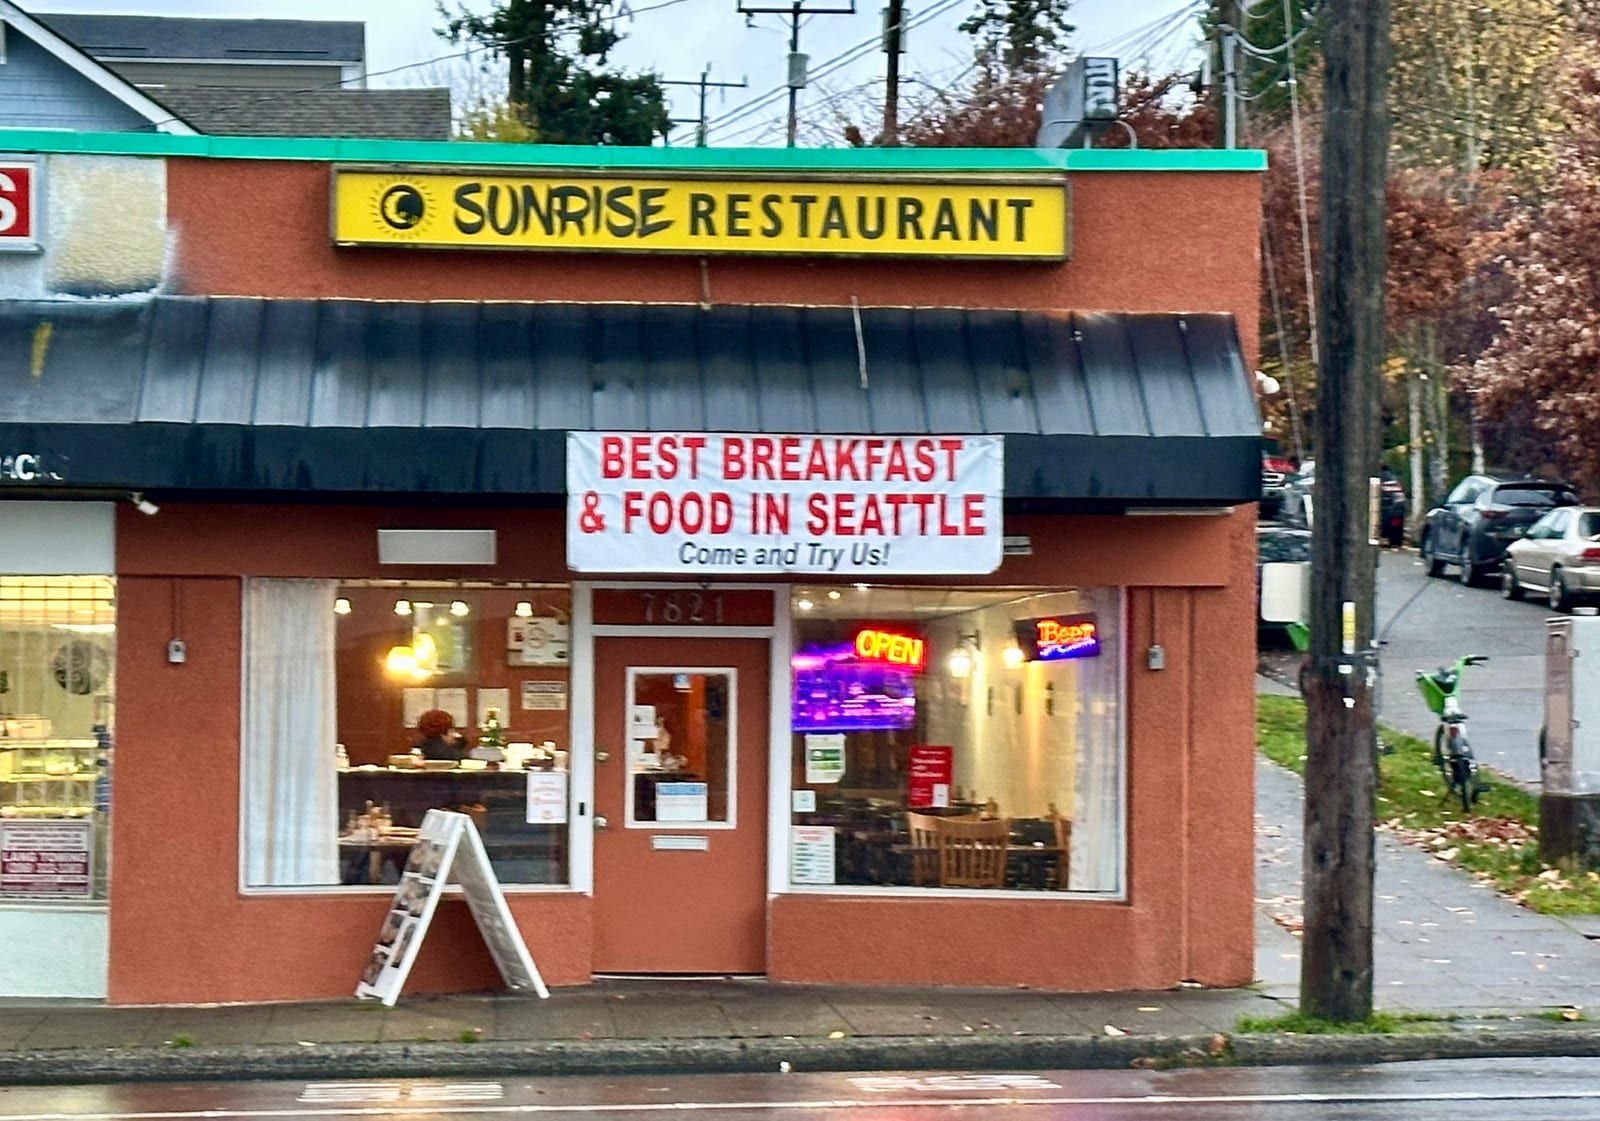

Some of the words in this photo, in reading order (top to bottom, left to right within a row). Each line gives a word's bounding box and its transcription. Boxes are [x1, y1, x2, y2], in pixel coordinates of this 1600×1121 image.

[452, 182, 676, 239] SUNRISE
[688, 192, 1034, 243] RESTAURANT
[601, 435, 706, 481] BEST
[721, 436, 964, 483] BREAKFAST
[579, 489, 606, 534] &
[623, 489, 733, 535] FOOD
[750, 491, 790, 536] IN
[806, 491, 986, 537] SEATTLE
[679, 540, 747, 566] Come
[752, 542, 801, 567] and
[807, 542, 846, 572] Try
[851, 541, 892, 567] Us!
[640, 591, 725, 625] 7821
[855, 629, 924, 666] OPEN
[1036, 619, 1096, 648] Beer
